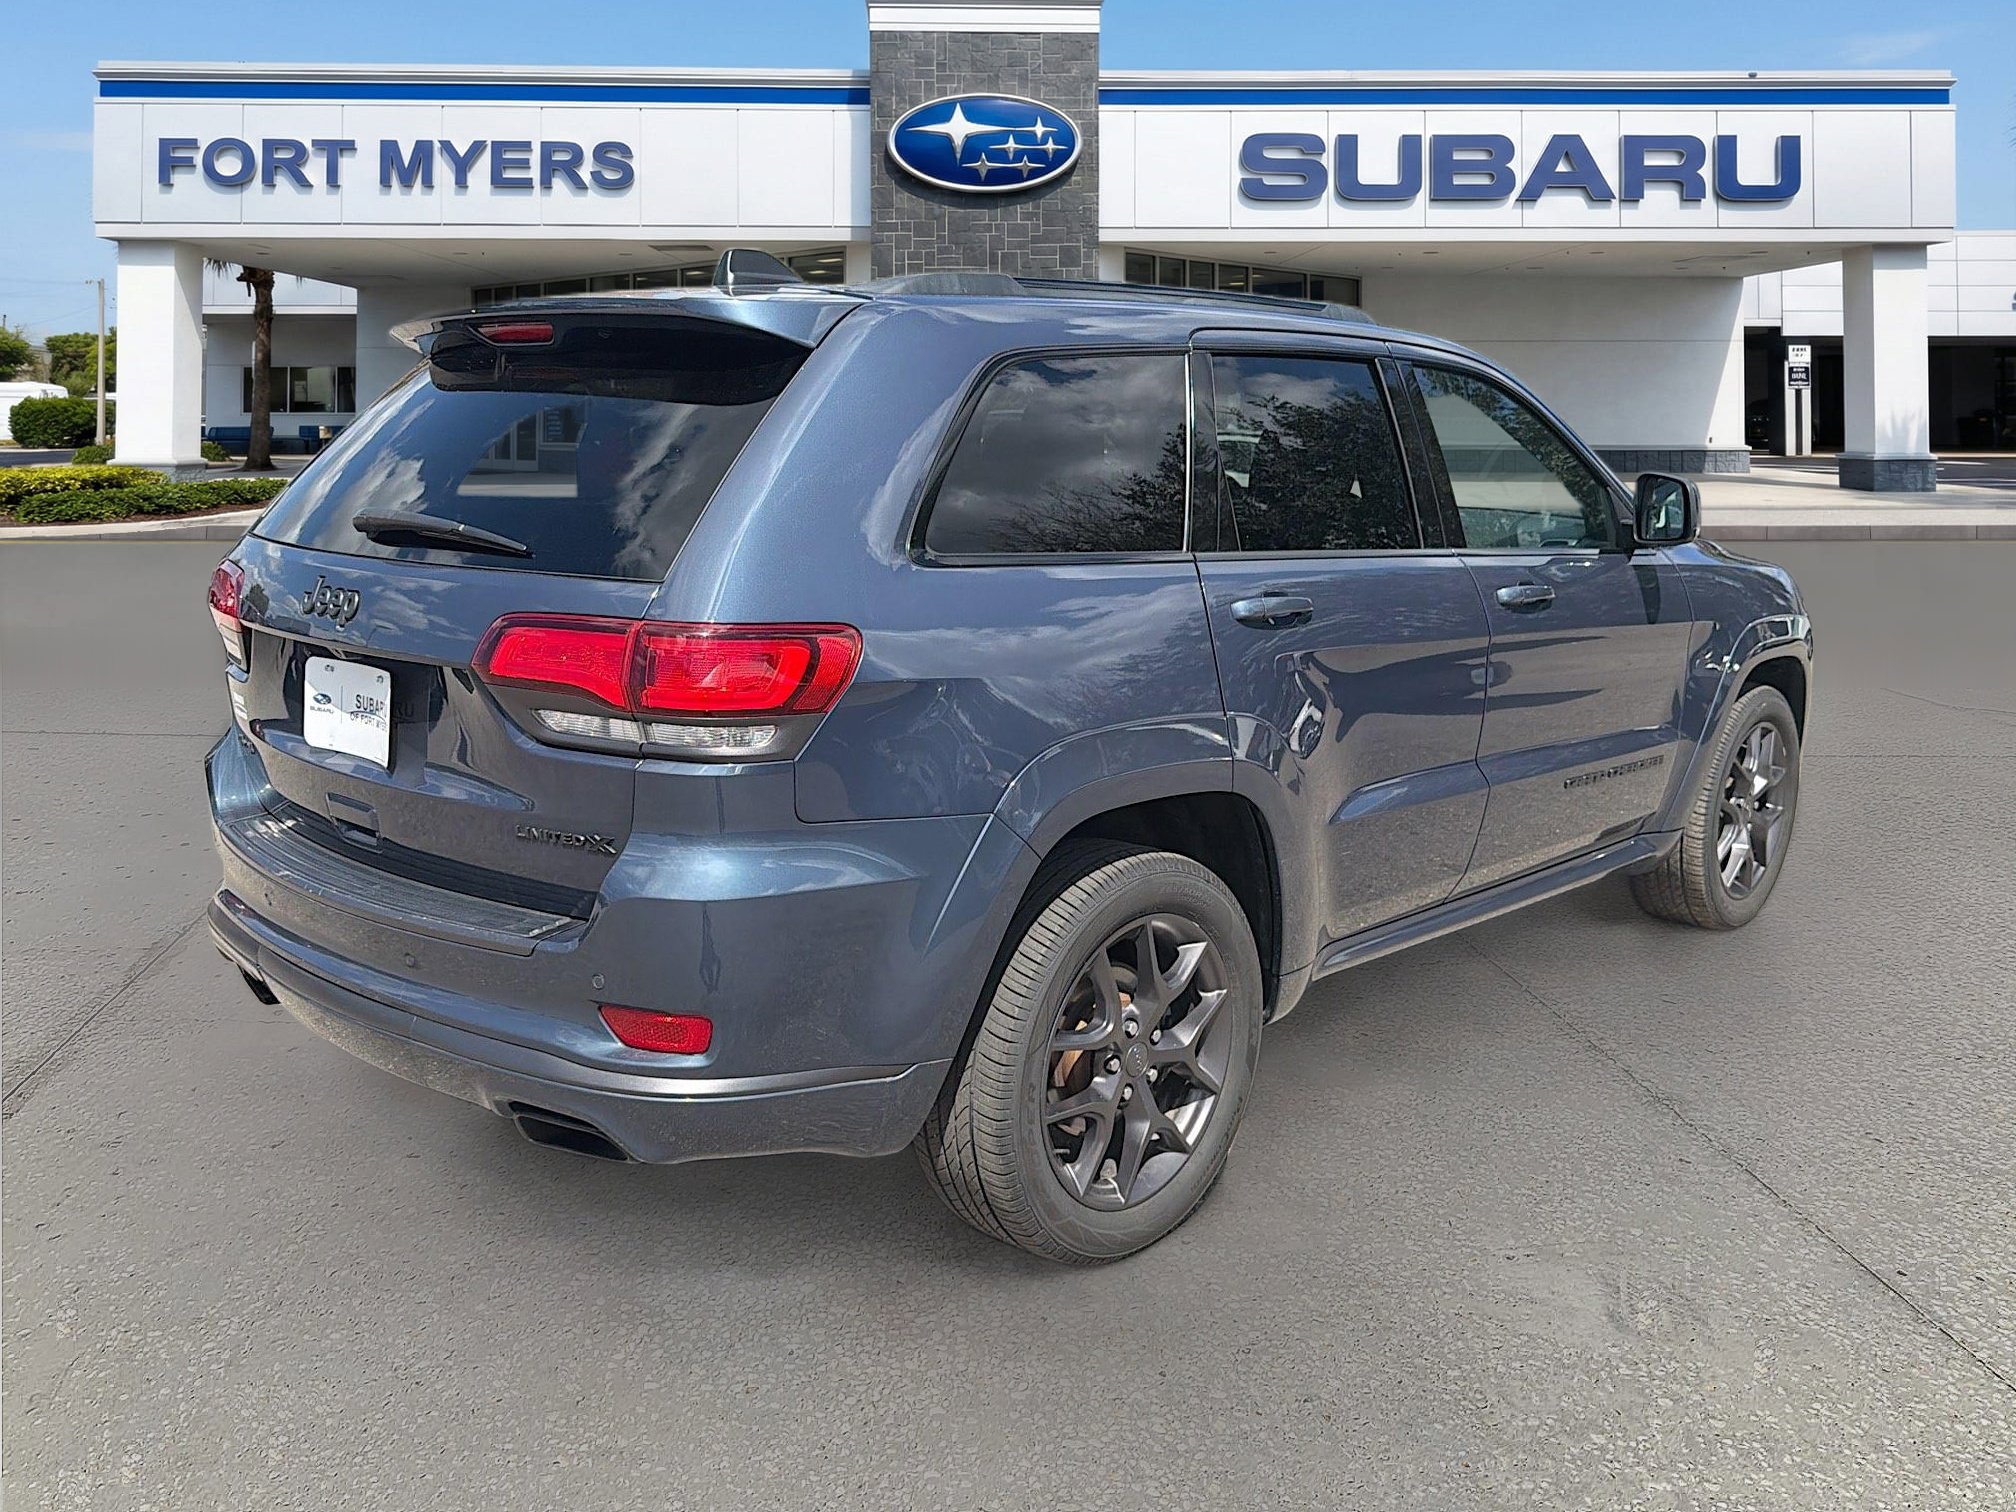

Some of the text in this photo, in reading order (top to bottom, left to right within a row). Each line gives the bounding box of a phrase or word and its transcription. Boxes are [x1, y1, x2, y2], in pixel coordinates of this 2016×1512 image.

[158, 138, 635, 191] FORT MYERS
[1240, 133, 1801, 202] SUBARU
[302, 575, 360, 629] Jeep
[516, 824, 617, 855] LIMITED X
